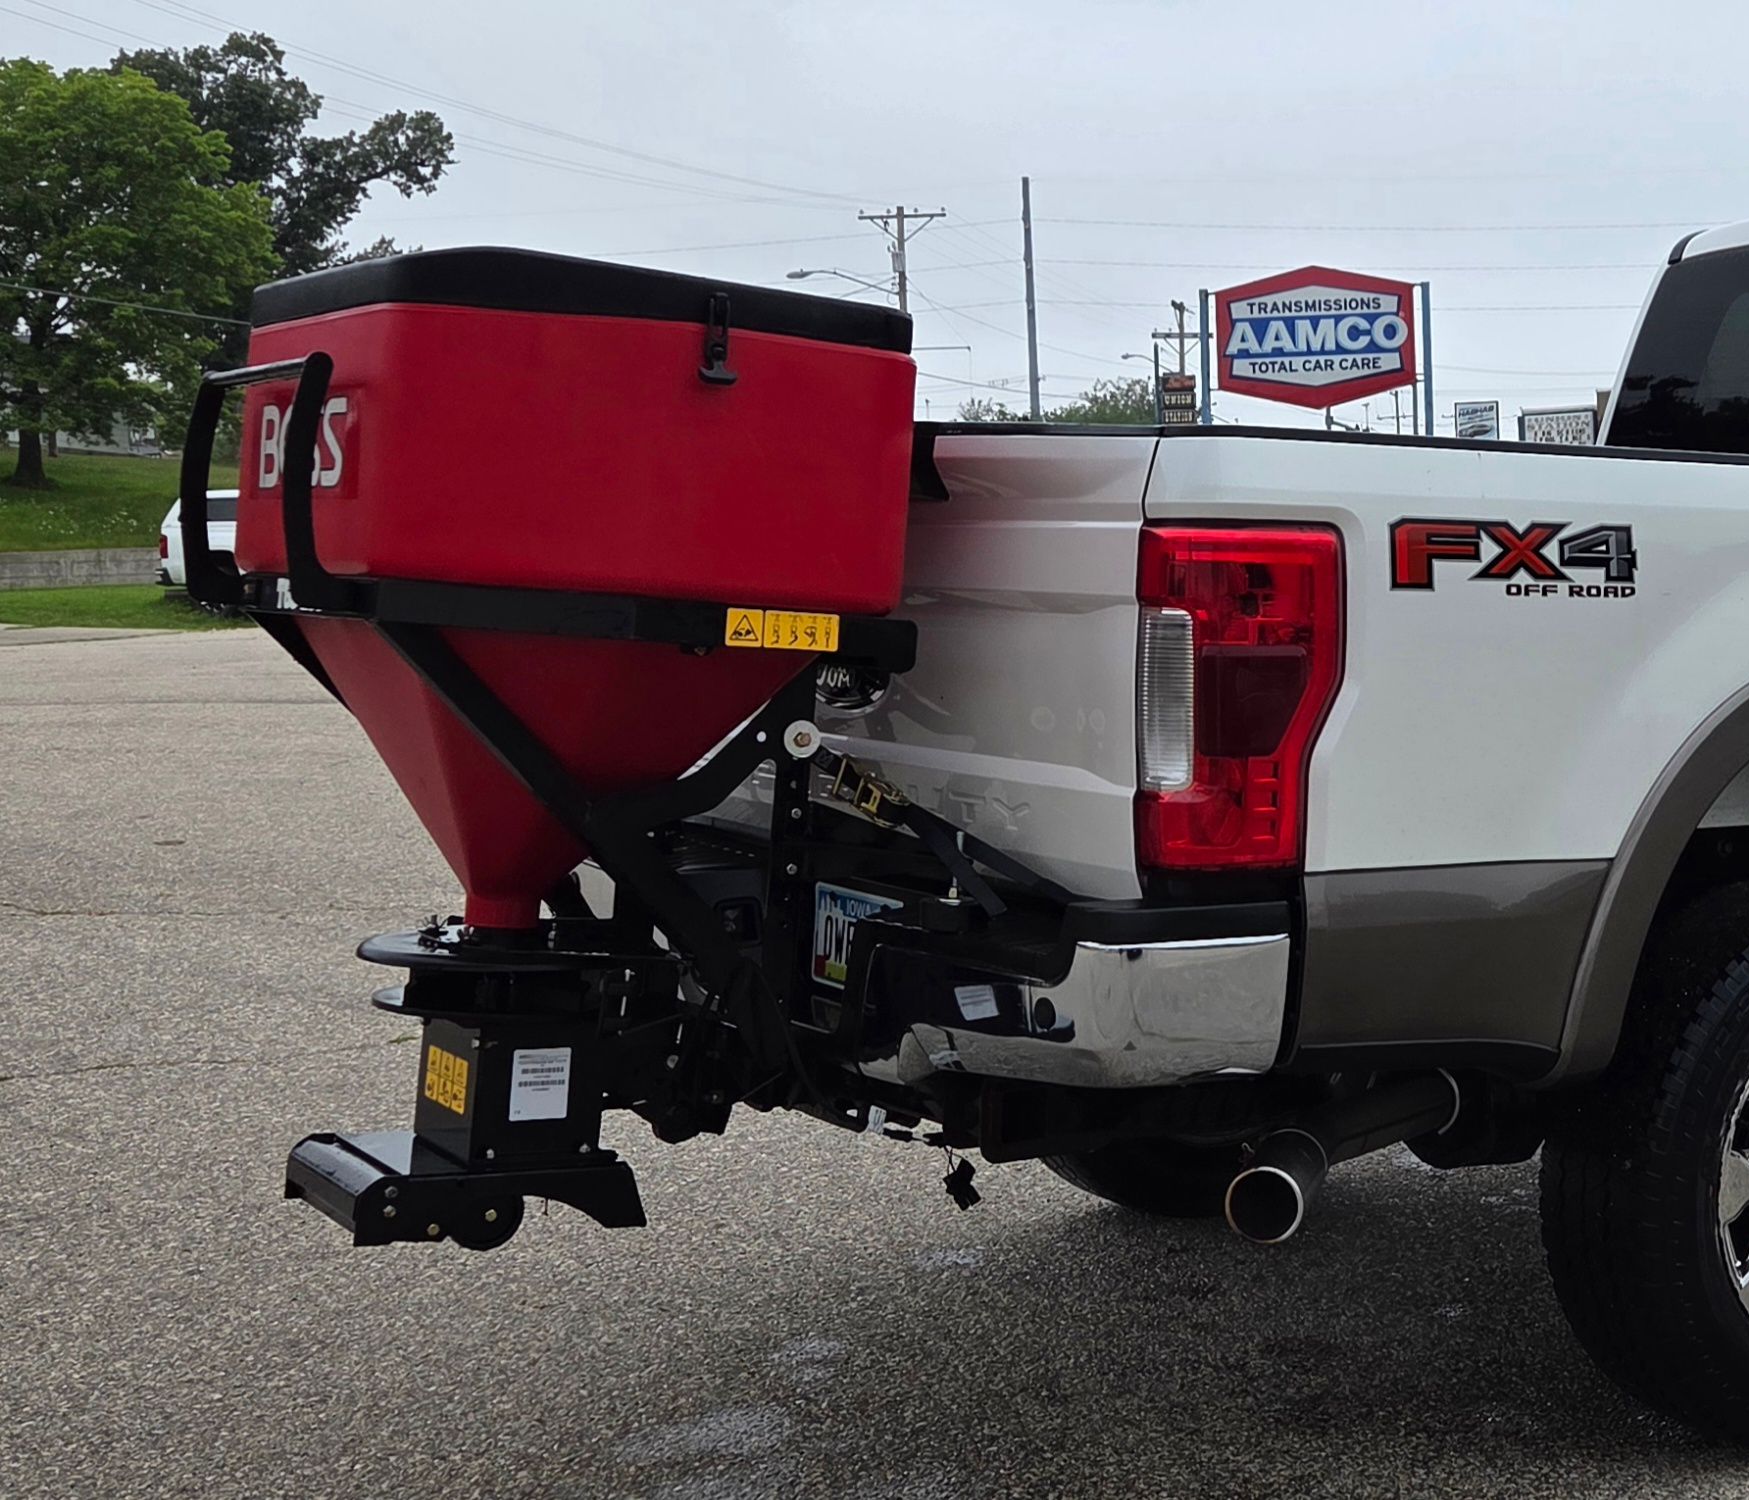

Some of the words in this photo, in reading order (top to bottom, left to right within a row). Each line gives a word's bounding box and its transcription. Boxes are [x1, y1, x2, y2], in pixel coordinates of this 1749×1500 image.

[1246, 297, 1382, 315] TRANSMISSIONS
[1225, 314, 1409, 355] AAMCO
[1249, 360, 1298, 375] TOTAL
[1302, 358, 1335, 372] CAR
[1339, 356, 1382, 370] CARE
[1387, 515, 1638, 592] FX4
[1505, 583, 1559, 597] OFF
[1568, 584, 1636, 599] ROAD
